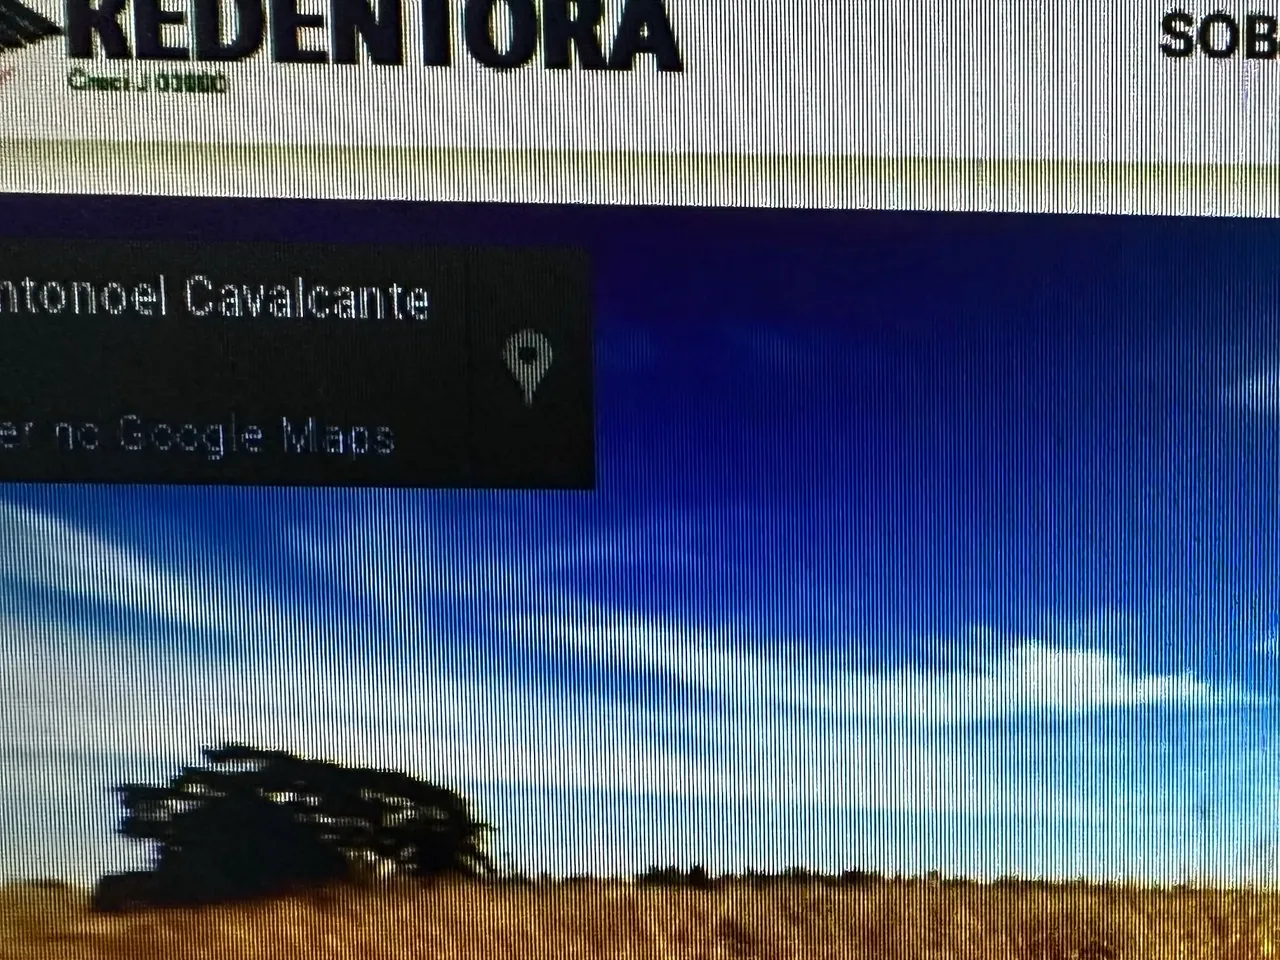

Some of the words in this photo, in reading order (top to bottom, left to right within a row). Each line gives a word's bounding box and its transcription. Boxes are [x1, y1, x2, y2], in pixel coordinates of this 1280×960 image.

[186, 275, 430, 321] Cavalcante
[55, 422, 101, 451] no
[118, 413, 264, 460] Google
[281, 415, 397, 460] Maps
